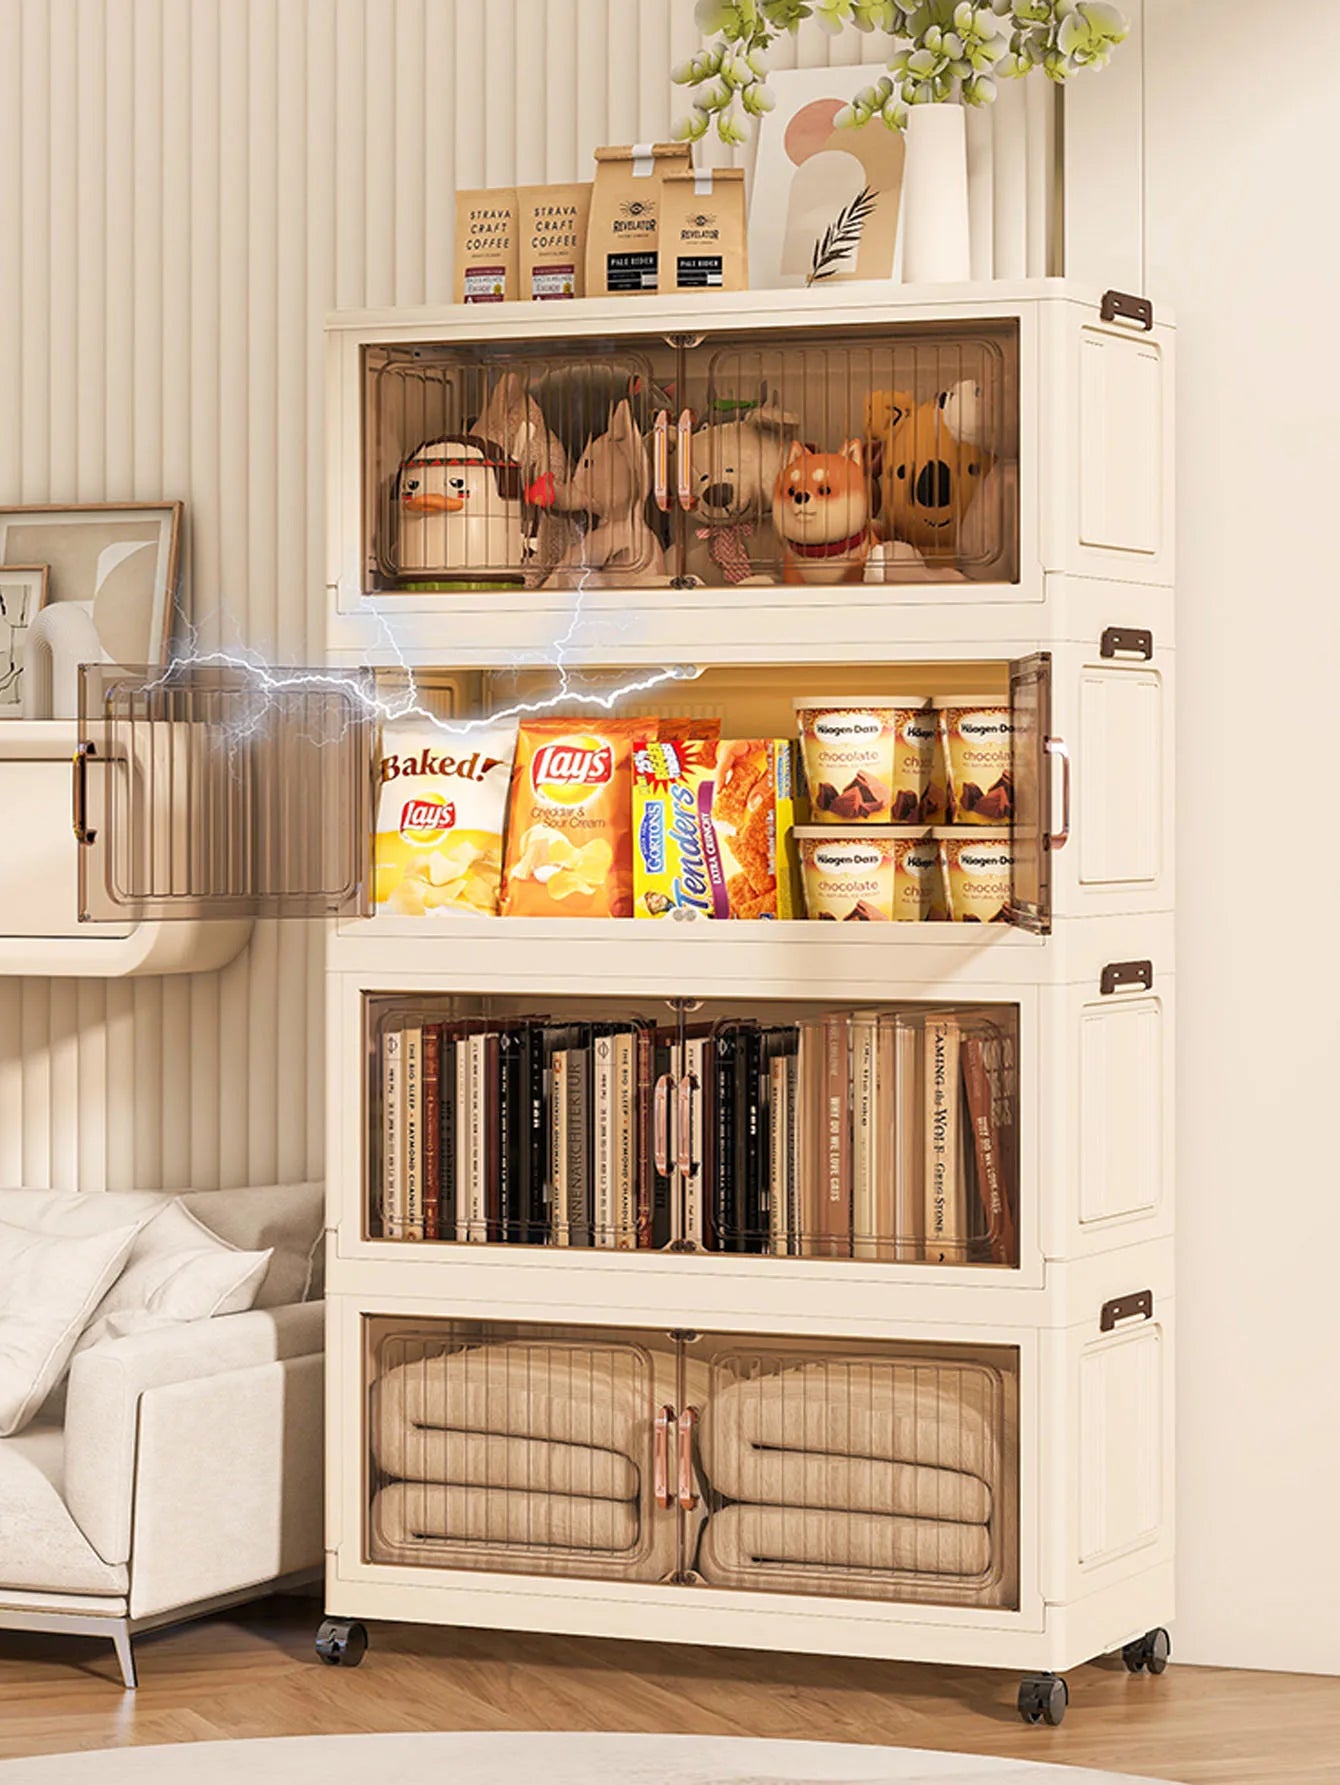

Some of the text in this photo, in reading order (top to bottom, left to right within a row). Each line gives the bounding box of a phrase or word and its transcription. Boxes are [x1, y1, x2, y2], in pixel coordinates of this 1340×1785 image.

[470, 209, 512, 220] STRAVA
[534, 206, 577, 217] STRAVA
[470, 222, 507, 234] CRAFT
[535, 219, 573, 232] CRAFT
[613, 219, 657, 232] REVELATOR
[680, 229, 720, 240] REVELATOR
[466, 238, 510, 250] COFFEE
[531, 235, 577, 248] COFFEE
[961, 723, 1015, 736] Häagen-Da
[818, 749, 878, 761] chocolate
[962, 750, 1011, 762] chocola
[380, 748, 504, 785] Baked!
[543, 816, 606, 829] Sour Cream
[669, 784, 709, 909] Tenders
[961, 855, 1015, 867] Häagen-Da
[817, 880, 878, 892] chocolate
[962, 881, 1011, 893] chocola
[408, 1043, 416, 1060] THE
[408, 1064, 416, 1080] BIG
[408, 1083, 416, 1110] SLEEP
[408, 1122, 416, 1173] RAYMOND
[621, 1128, 629, 1178] RAYMOND
[830, 1097, 840, 1203] WHY DO WE LOVE CATS
[934, 1196, 944, 1233] STONE
